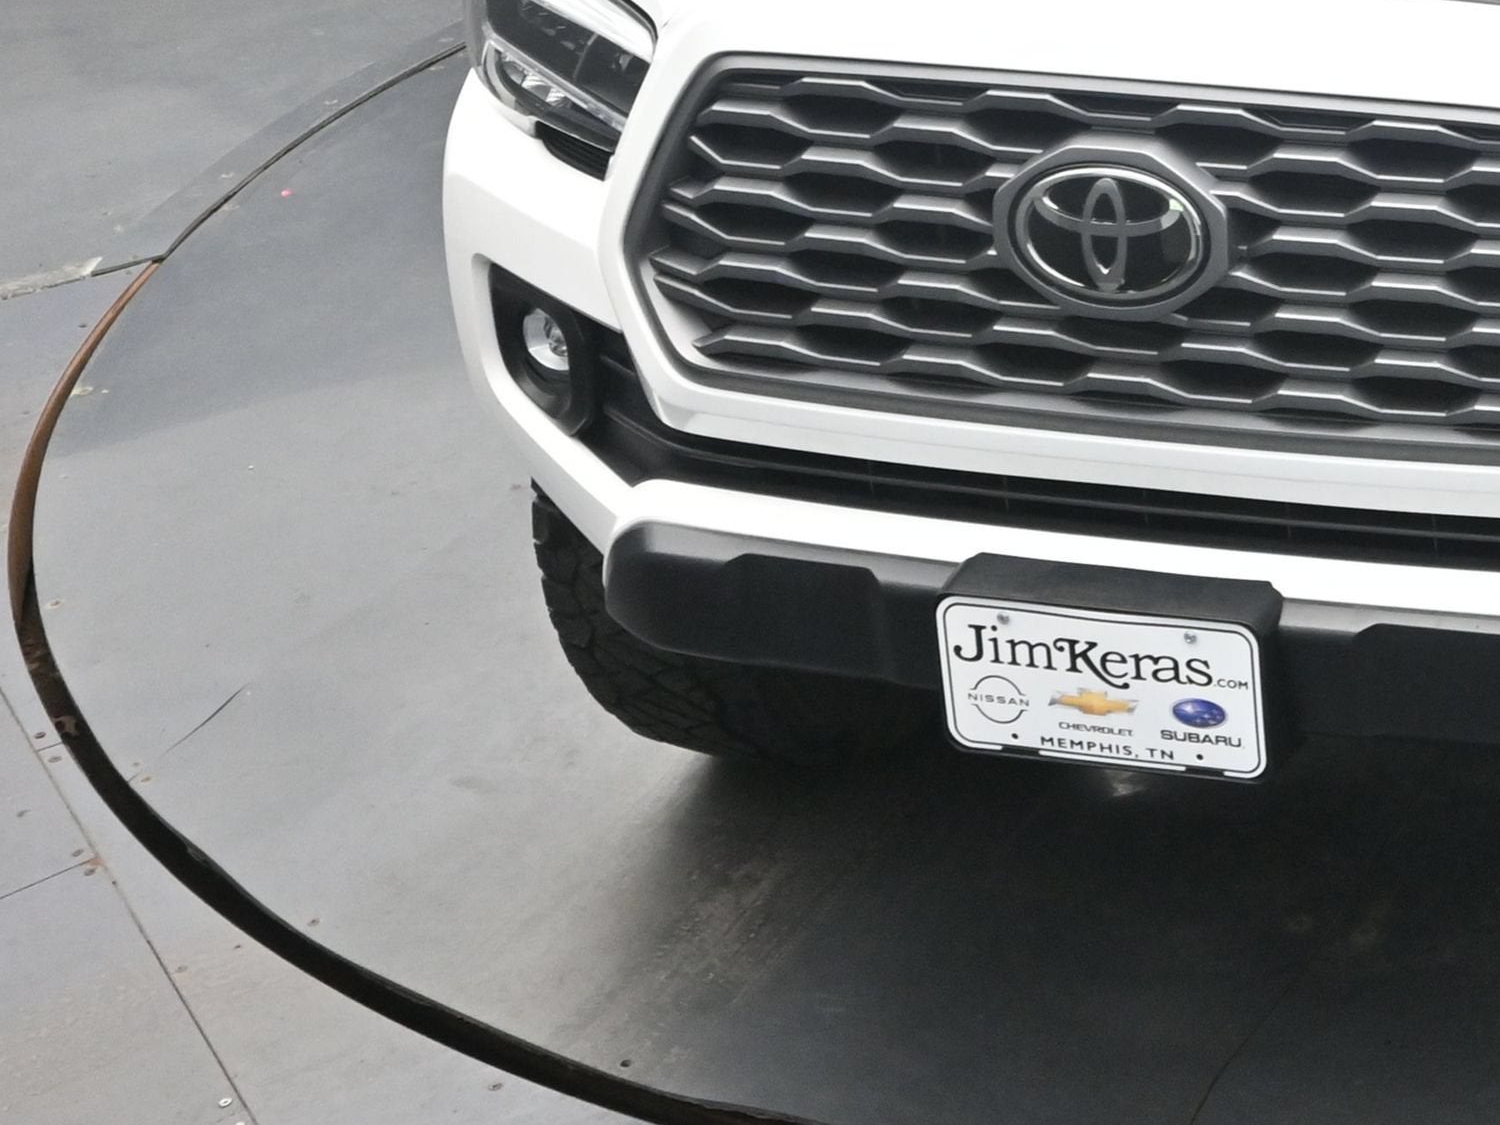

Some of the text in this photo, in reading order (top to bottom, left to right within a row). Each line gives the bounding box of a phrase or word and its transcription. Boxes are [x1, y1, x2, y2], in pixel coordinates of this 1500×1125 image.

[967, 692, 1030, 707] NISSAN
[1058, 721, 1134, 737] CHEVROLET
[1160, 729, 1242, 748] SUBARU
[1040, 735, 1175, 761] MEMPHIS, TN
